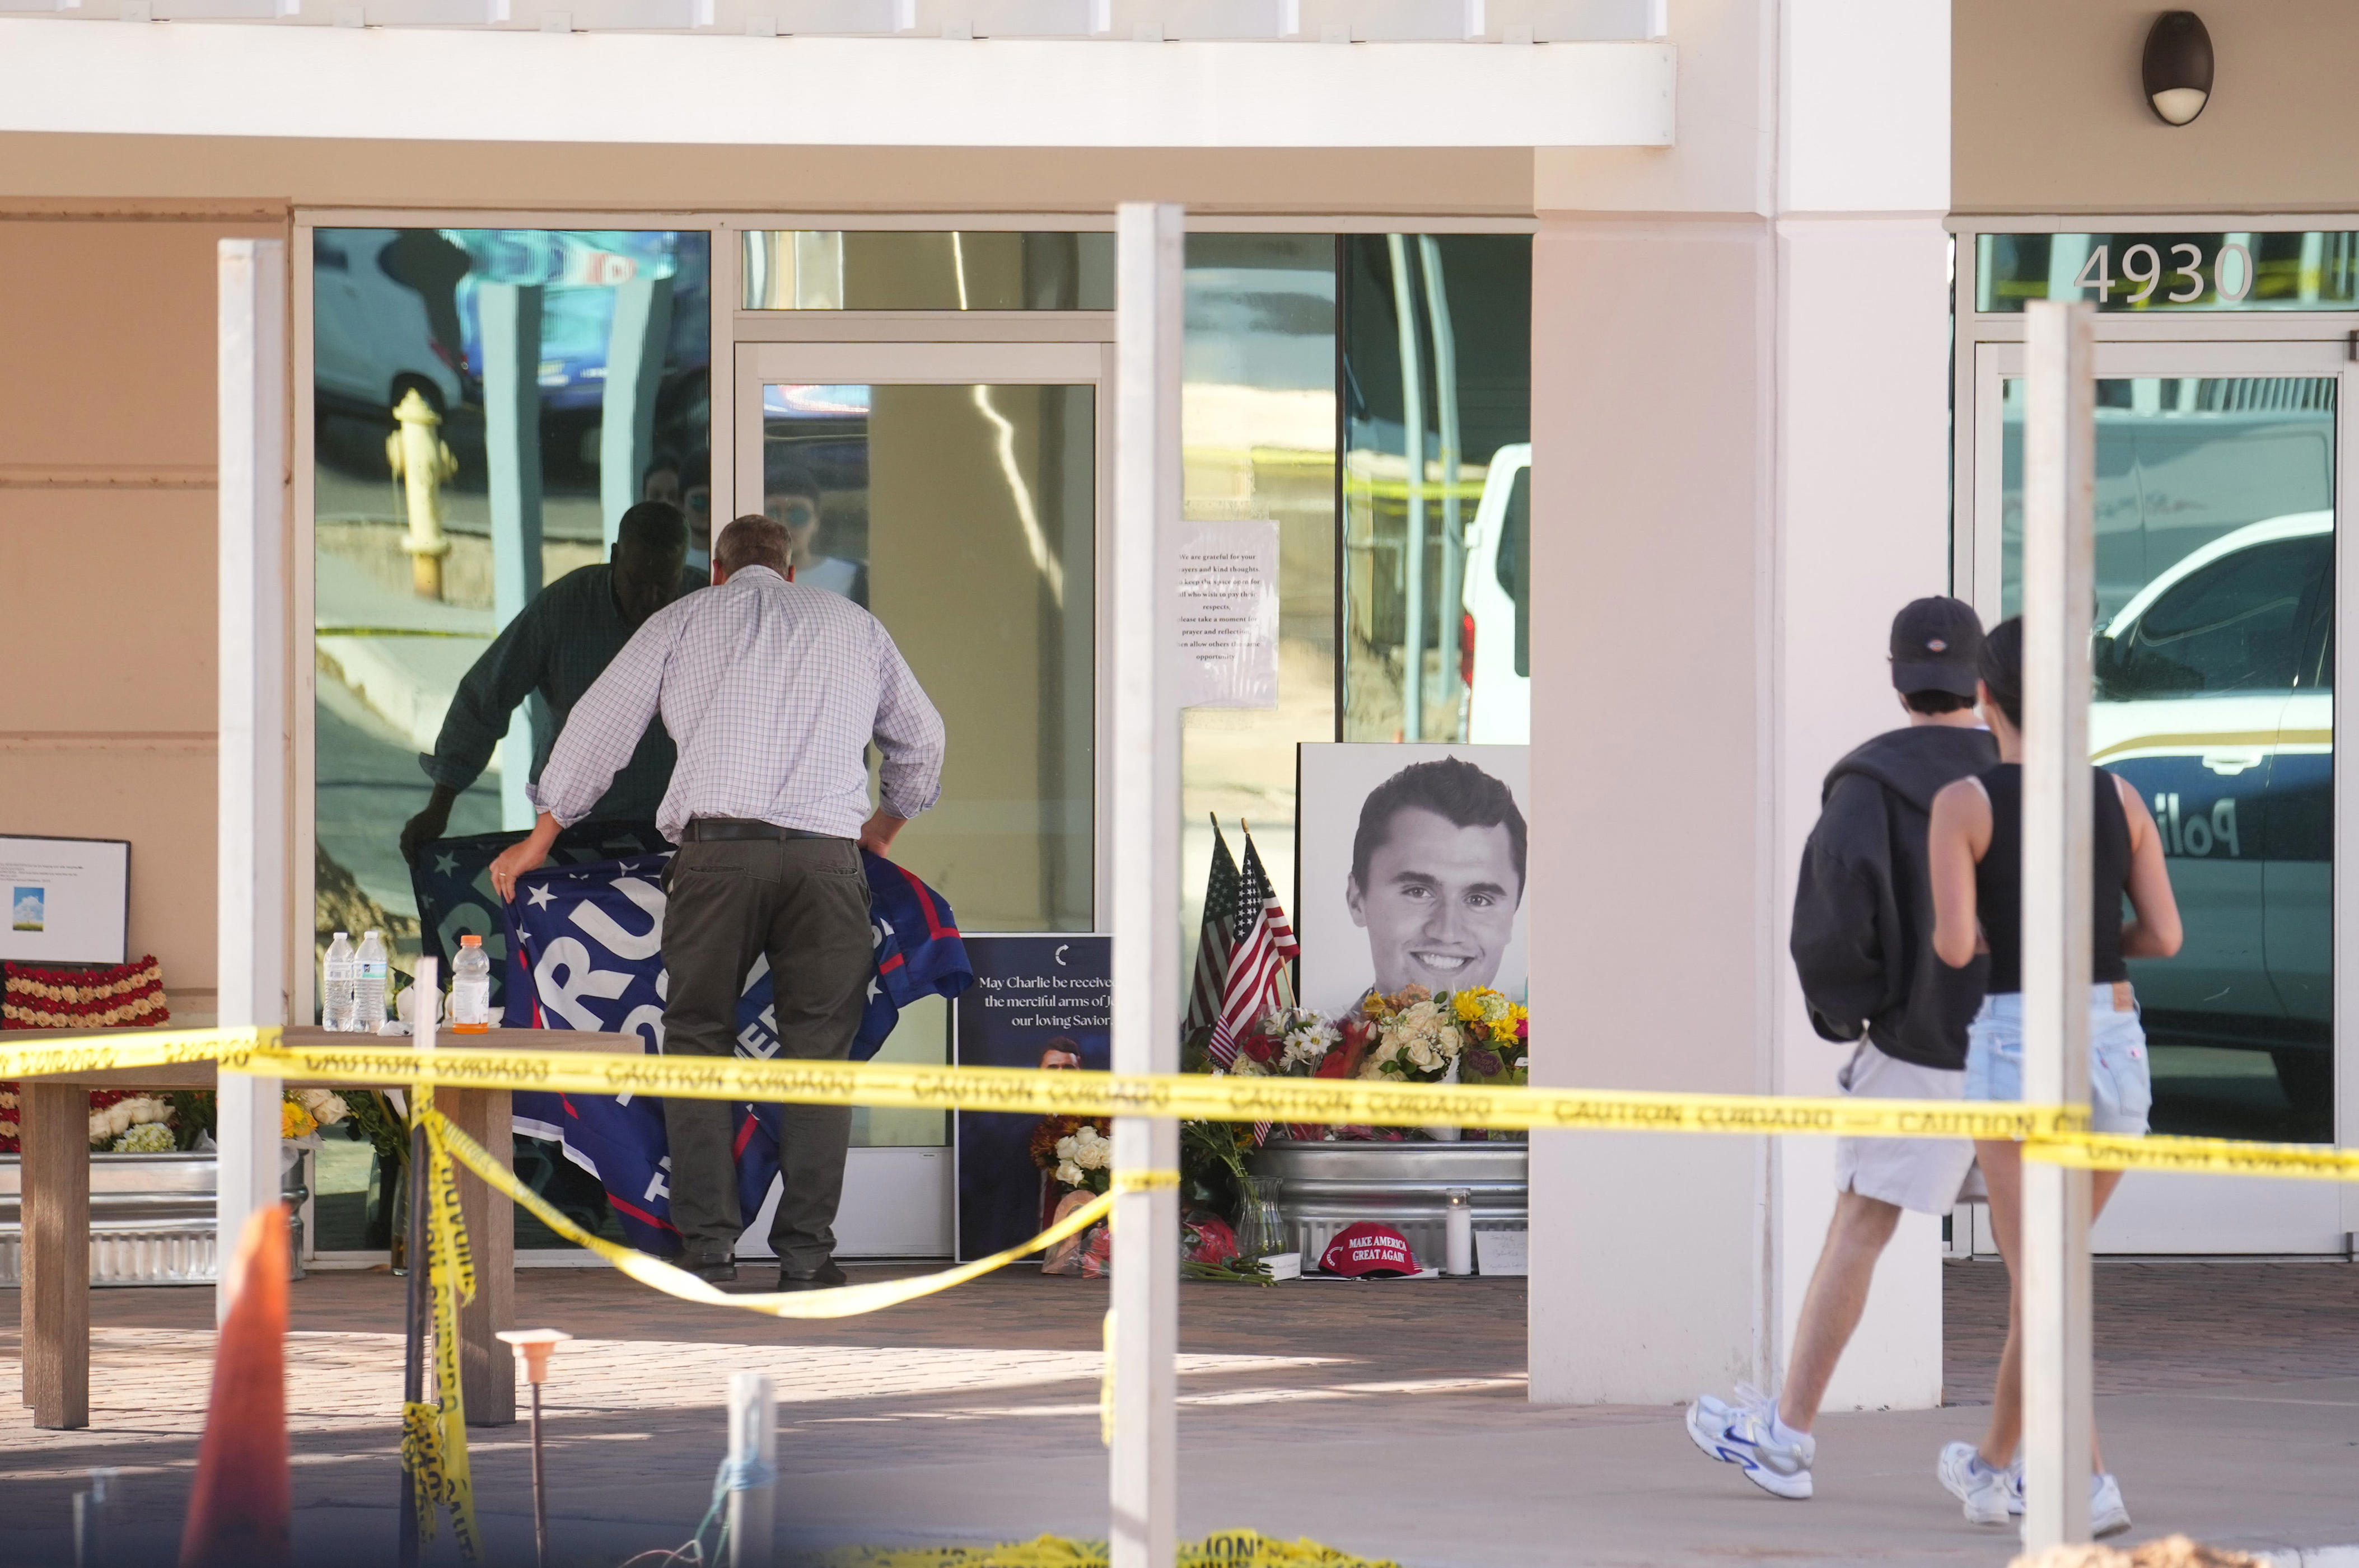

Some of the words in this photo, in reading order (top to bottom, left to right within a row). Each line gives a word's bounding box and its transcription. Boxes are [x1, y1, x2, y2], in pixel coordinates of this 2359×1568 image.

[2073, 243, 2253, 303] 4930
[1203, 553, 1228, 561] grateful
[1230, 566, 1260, 574] thoughts.
[979, 976, 1005, 990] May
[1007, 976, 1050, 988] Charlie
[1053, 976, 1068, 988] be
[985, 995, 1005, 1007] the
[1007, 995, 1055, 1007] merciful
[1058, 998, 1089, 1007] arms
[1091, 995, 1106, 1007] of
[1011, 1017, 1033, 1026] our
[1036, 1014, 1072, 1029] loving
[1898, 1111, 2036, 1135] CAUTION
[1348, 1237, 1373, 1249] MAKE
[1373, 1235, 1407, 1252] AMERICA
[1352, 1249, 1380, 1262] GREAT
[1380, 1251, 1405, 1263] AGAIN
